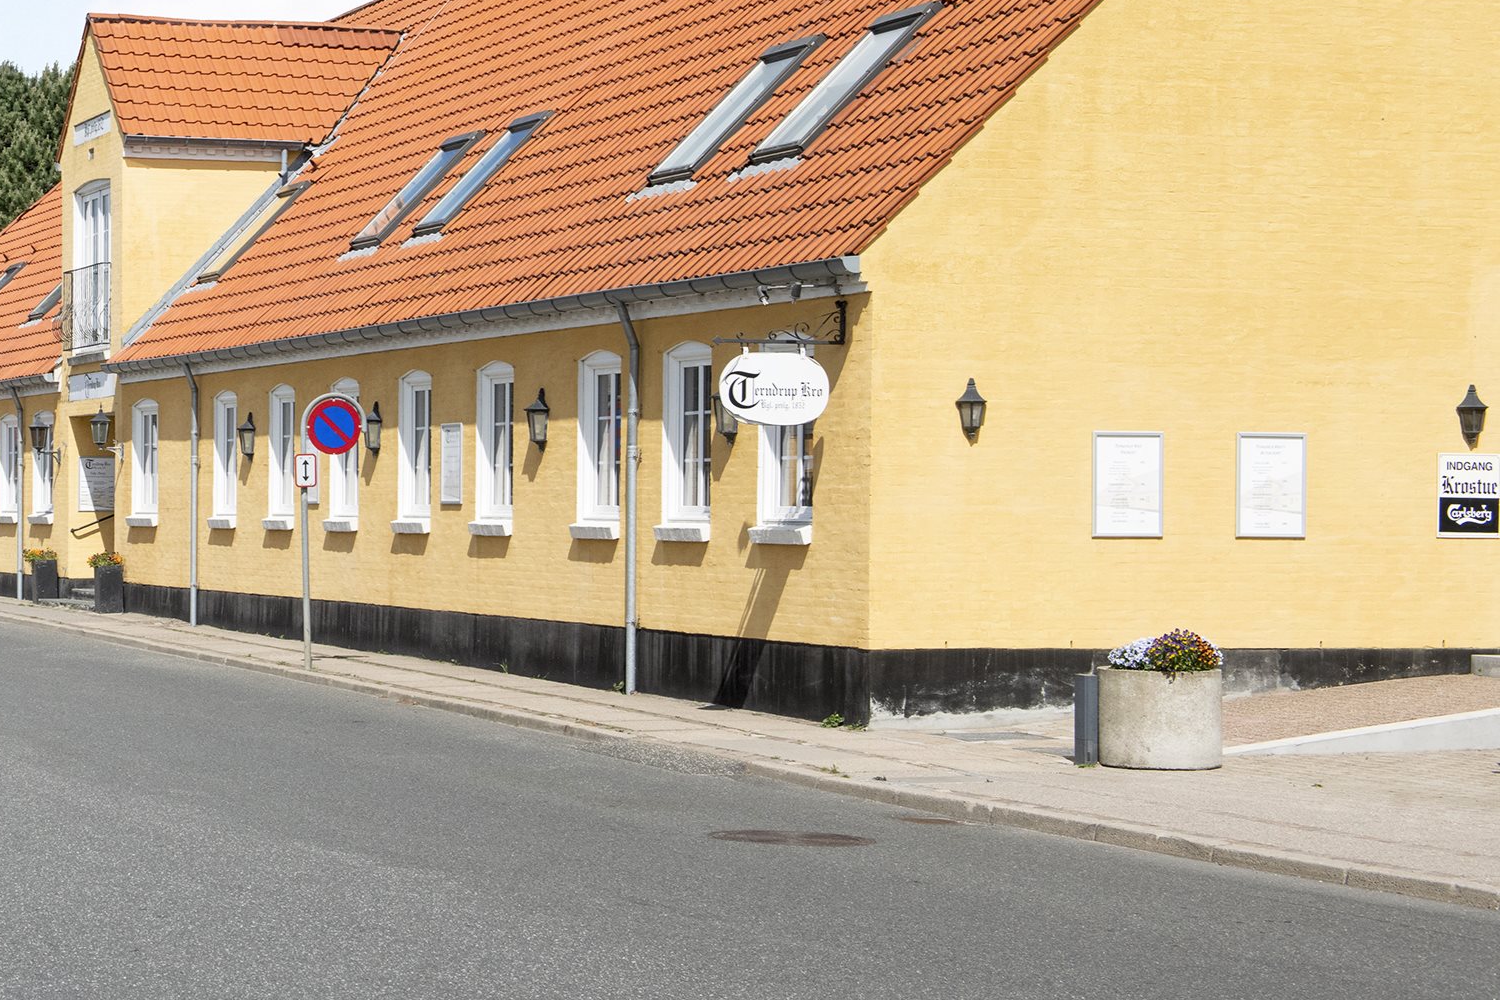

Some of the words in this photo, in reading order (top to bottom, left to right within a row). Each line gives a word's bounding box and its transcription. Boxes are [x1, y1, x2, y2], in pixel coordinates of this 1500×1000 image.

[724, 370, 798, 409] Terndrup
[801, 382, 823, 398] Kro
[1446, 461, 1493, 471] INDGANG
[1442, 475, 1498, 495] Krostue
[1446, 503, 1493, 525] Carlsberg
